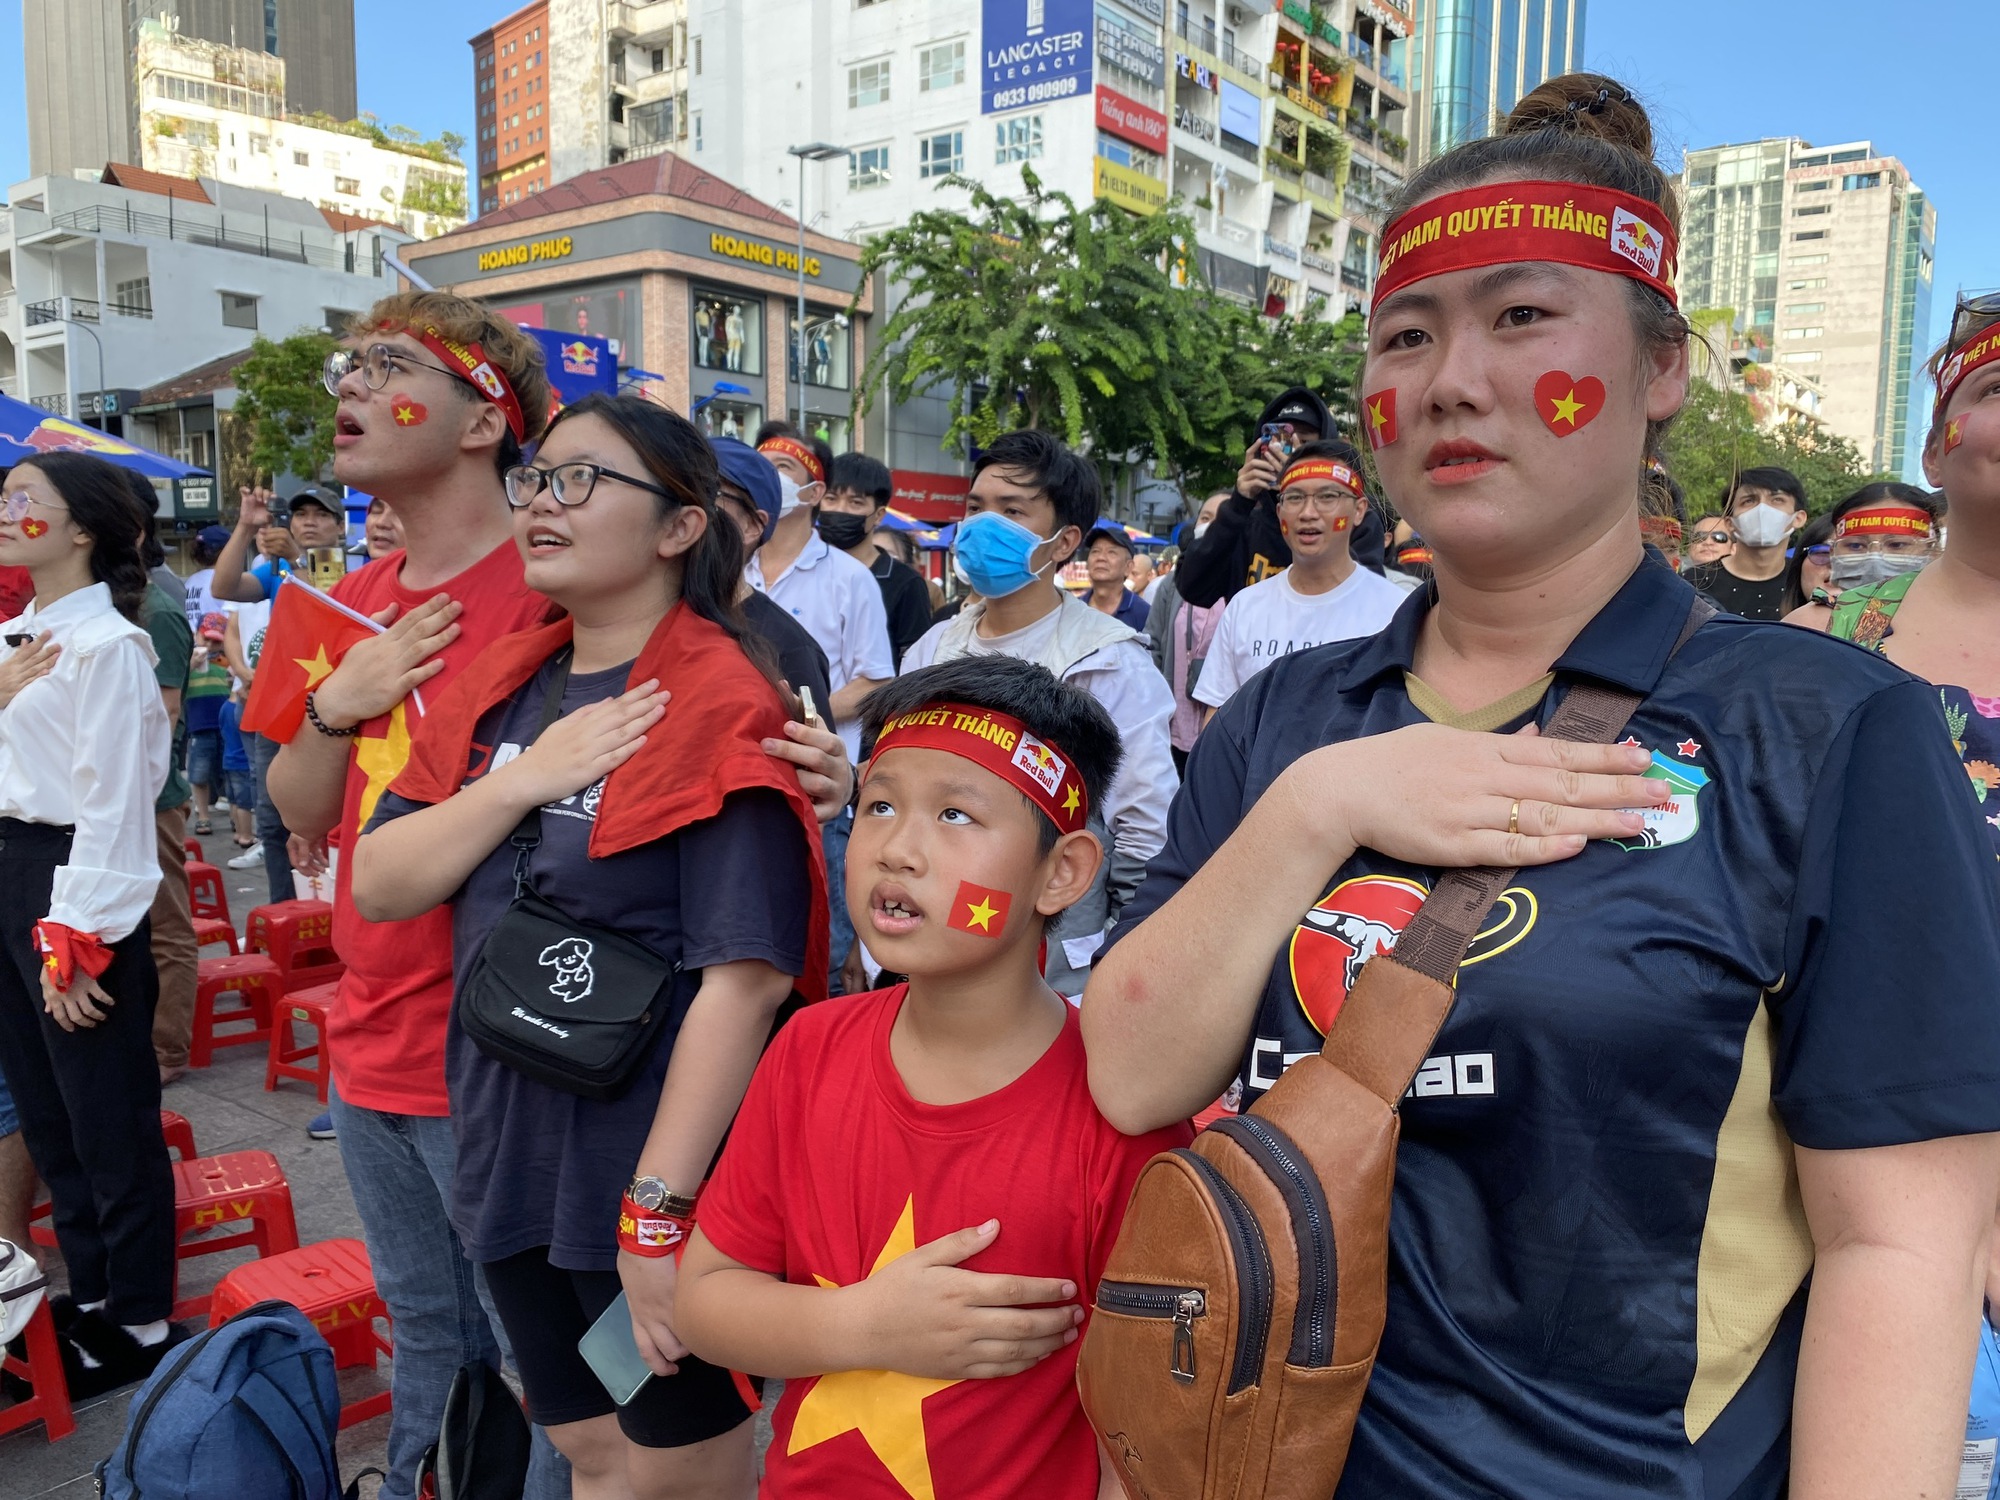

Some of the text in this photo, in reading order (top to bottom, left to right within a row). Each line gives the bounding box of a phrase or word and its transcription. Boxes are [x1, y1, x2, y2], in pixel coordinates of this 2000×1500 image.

[987, 31, 1084, 68] LANCASTER
[993, 54, 1076, 82] LEGACY
[993, 76, 1078, 109] 0933 090909
[1398, 216, 1442, 258] NAM
[1447, 197, 1524, 238] QUYẾT
[1530, 200, 1608, 240] THẮNG
[479, 235, 573, 271] HOANG PHUC
[711, 232, 773, 266] HOANG
[1618, 238, 1656, 273] Red Bull
[1963, 339, 1990, 366] VIỆT
[764, 439, 818, 474] VIỆT NAM
[1860, 517, 1881, 527] NAM
[1883, 515, 1911, 528] QUYẾT
[897, 705, 952, 730] QUYẾT
[952, 713, 1017, 752] THẮNG
[1019, 754, 1055, 790] Red Bull
